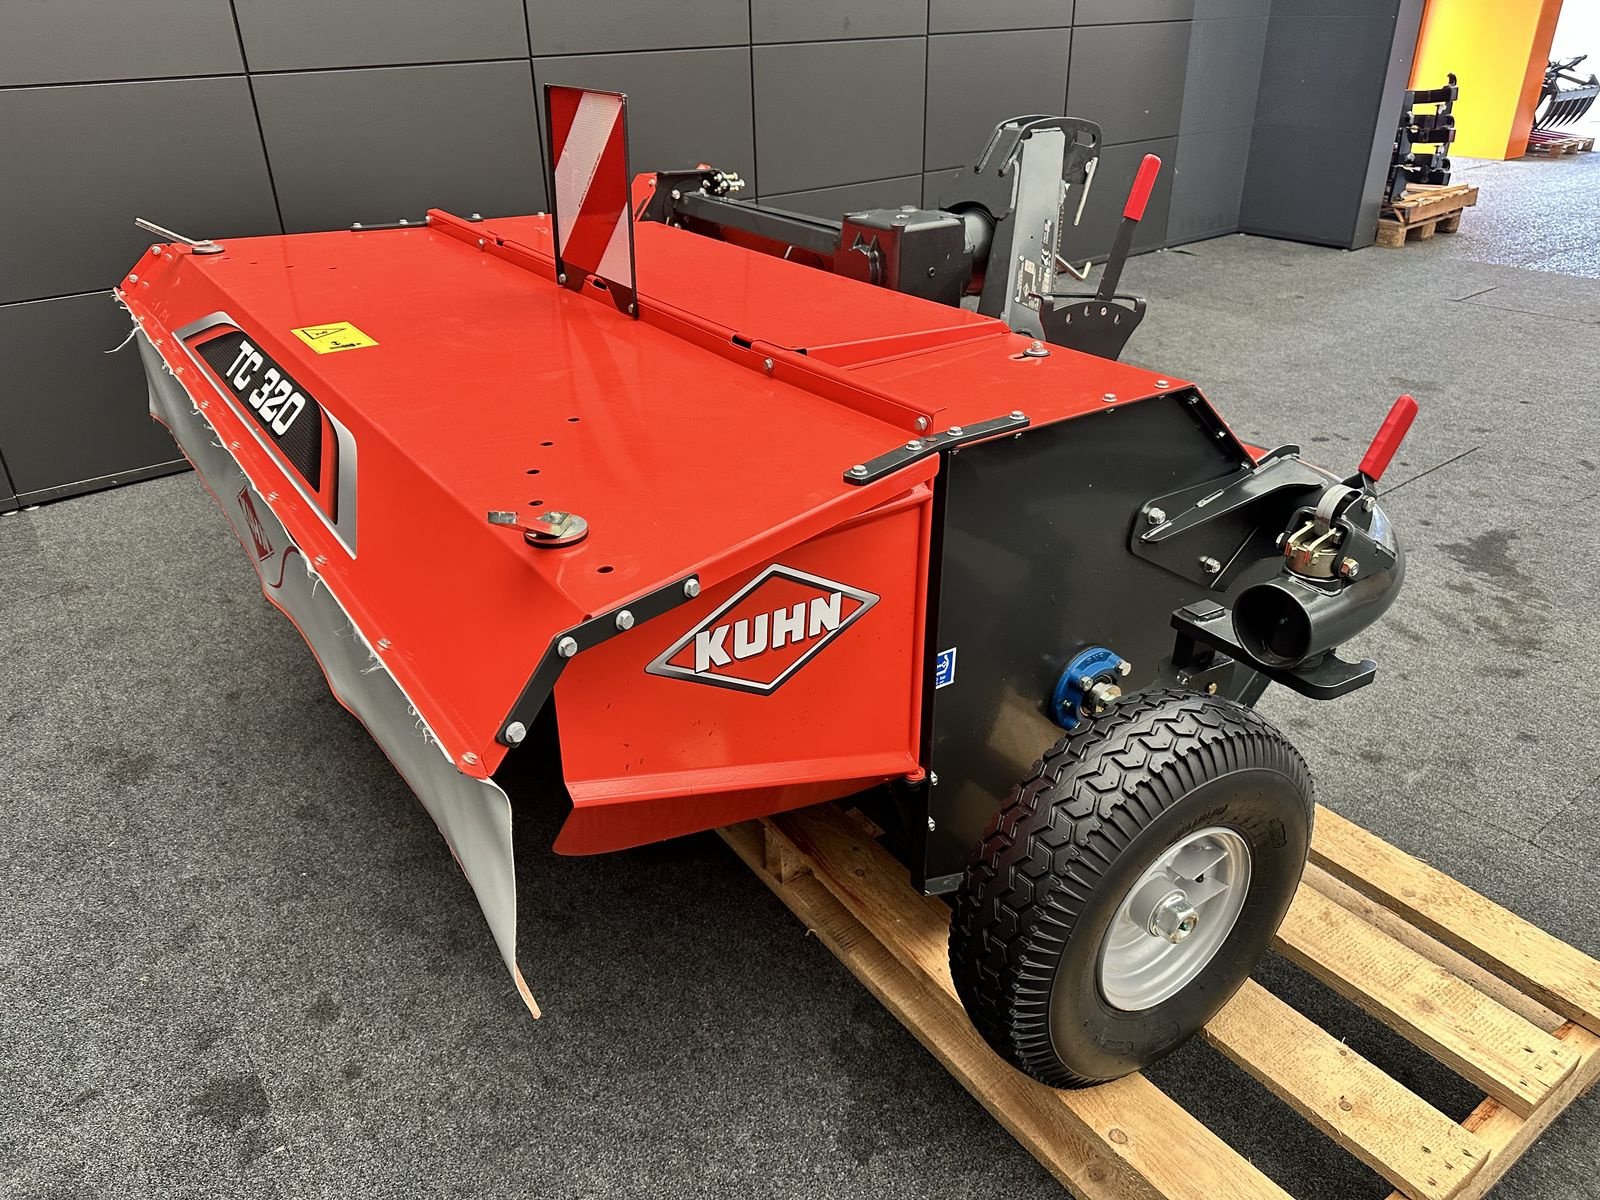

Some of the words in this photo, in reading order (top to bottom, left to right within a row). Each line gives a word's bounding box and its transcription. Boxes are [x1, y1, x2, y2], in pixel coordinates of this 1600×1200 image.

[226, 340, 263, 390] TC
[249, 367, 305, 436] 320
[695, 592, 842, 673] KUHN
